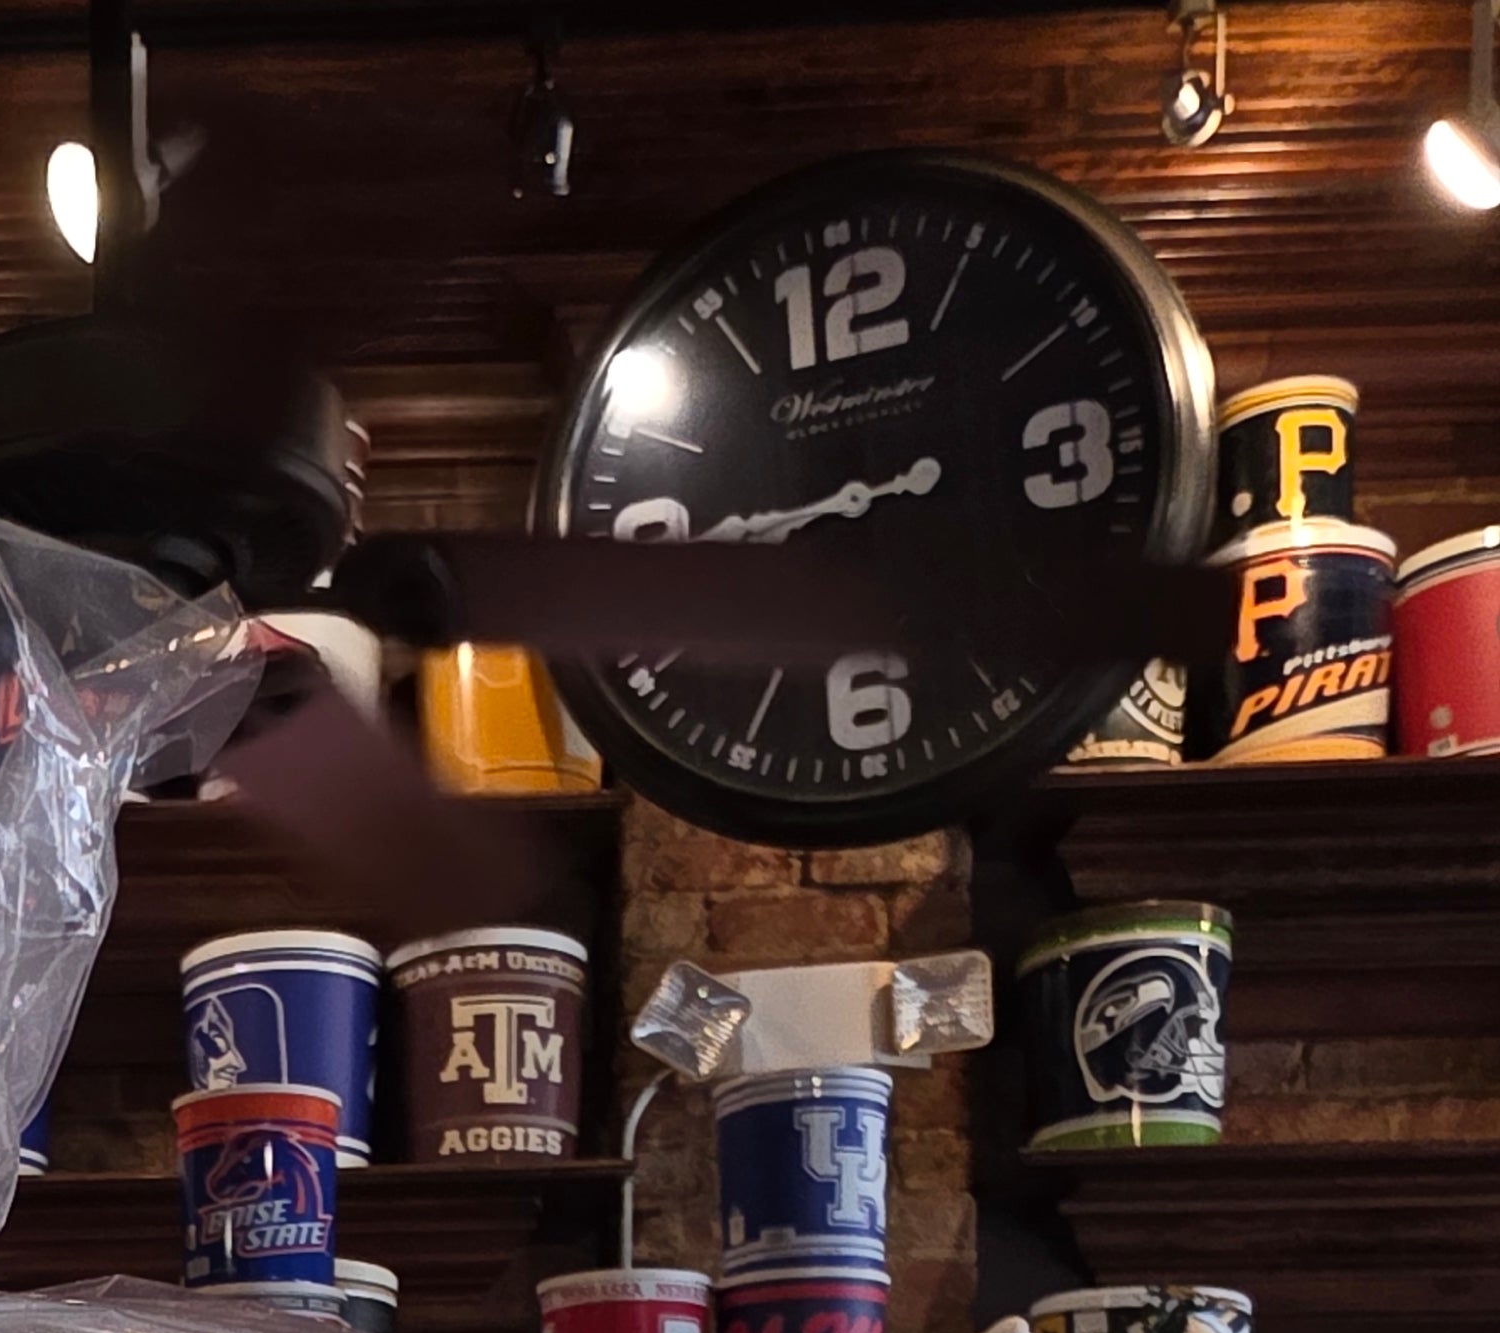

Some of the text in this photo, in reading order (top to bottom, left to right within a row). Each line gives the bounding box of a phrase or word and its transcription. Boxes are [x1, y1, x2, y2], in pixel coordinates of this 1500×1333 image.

[775, 246, 909, 370] 12
[1022, 399, 1115, 509] 3
[1276, 408, 1347, 518] P
[1235, 557, 1312, 663] P
[826, 650, 913, 751] 6
[439, 1126, 564, 1155] AGGIES
[243, 1221, 328, 1251] STATE
